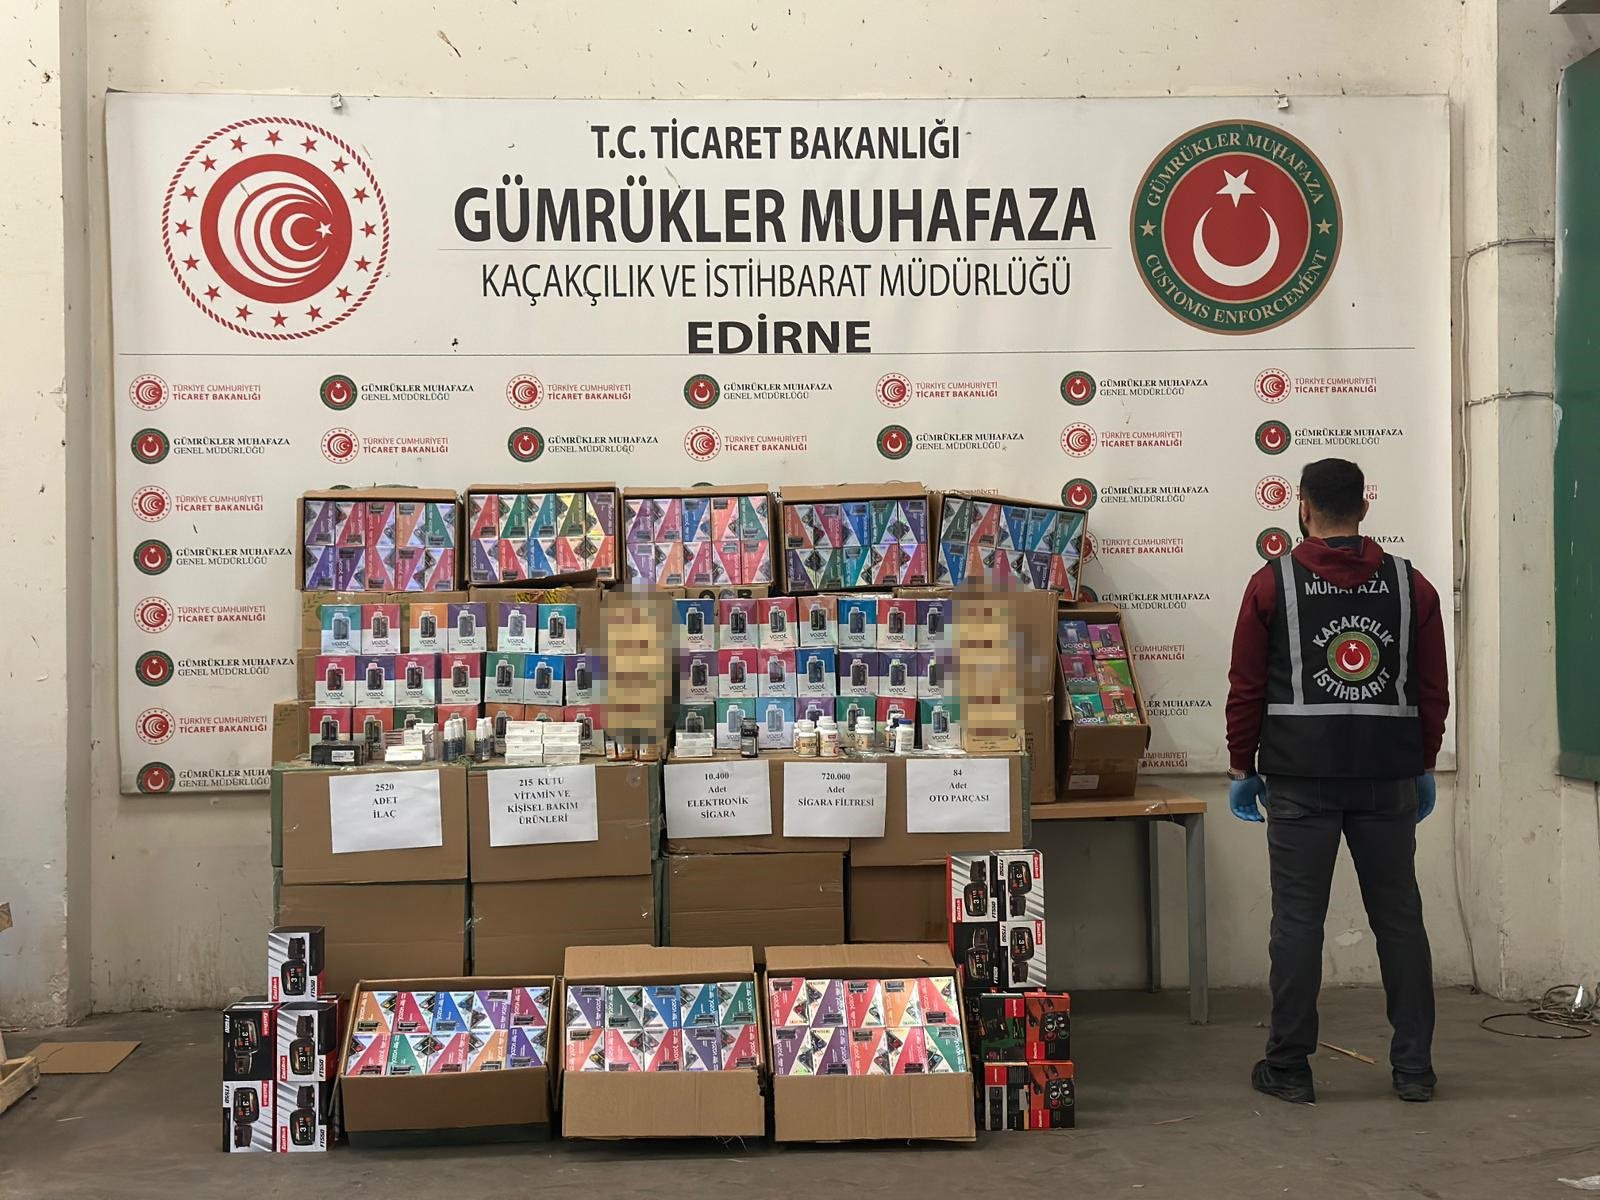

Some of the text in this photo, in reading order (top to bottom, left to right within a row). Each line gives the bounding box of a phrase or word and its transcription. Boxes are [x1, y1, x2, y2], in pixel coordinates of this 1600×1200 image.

[591, 118, 959, 159] T.C. TİCARET BAKANLIĞI
[1146, 132, 1325, 207] GÜMRÜKLER MUHAFAZA
[454, 174, 1096, 242] GÜMRÜKLER MUHAFAZA
[482, 256, 1071, 306] KAÇAKÇILIK VE İSTİHBARAT MÜDÜRLÜĞÜ
[1145, 250, 1328, 324] CUSTOMS ENFORCEMENT
[688, 313, 872, 354] EDİRNE
[423, 383, 474, 392] MUHAFAZA
[783, 383, 832, 391] MUHAFAZA
[1159, 379, 1208, 387] MUHAFAZA
[916, 389, 950, 398] TİCARET
[1100, 387, 1128, 396] GENEL
[1295, 385, 1329, 393] TİCARET
[173, 391, 209, 401] TİCARET
[361, 392, 391, 400] GENEL
[547, 391, 582, 400] TİCARET
[724, 391, 752, 399] GENEL
[238, 437, 290, 446] MUHAFAZA
[609, 436, 659, 444] MUHAFAZA
[975, 433, 1024, 441] MUHAFAZA
[1295, 437, 1323, 445] GENEL
[724, 443, 759, 451] TİCARET
[916, 441, 944, 450] GENEL
[1101, 439, 1134, 448] TİCARET
[174, 446, 203, 454] GENEL
[363, 444, 398, 454] TİCARET
[548, 444, 577, 453] GENEL
[1160, 486, 1209, 495] MUHAFAZA
[1101, 494, 1128, 503] GENEL
[176, 503, 212, 512] TİCARET
[240, 548, 293, 556] MUHAFAZA
[176, 556, 206, 565] GENEL
[1312, 615, 1394, 647] KAÇAKÇILIK
[1312, 667, 1391, 700] İSTİHBARAT
[243, 768, 272, 776] MUHA
[705, 772, 729, 780] 10.400
[821, 772, 851, 780] 720.000
[538, 777, 564, 785] KUTU
[375, 783, 395, 791] 2520
[708, 785, 727, 793] Adet
[949, 782, 967, 790] Adet
[514, 789, 555, 799] VİTAMİN
[929, 794, 989, 803] OTO PARÇASI
[372, 796, 398, 805] ADET
[687, 796, 748, 807] ELEKTRONİK
[798, 797, 874, 806] SİGARA FİLTRESİ
[507, 802, 578, 813] KİŞİSEL BAKIM
[373, 809, 396, 819] İLAÇ
[519, 812, 568, 824] ÜRÜNLERİ
[700, 809, 736, 818] SİGARA
